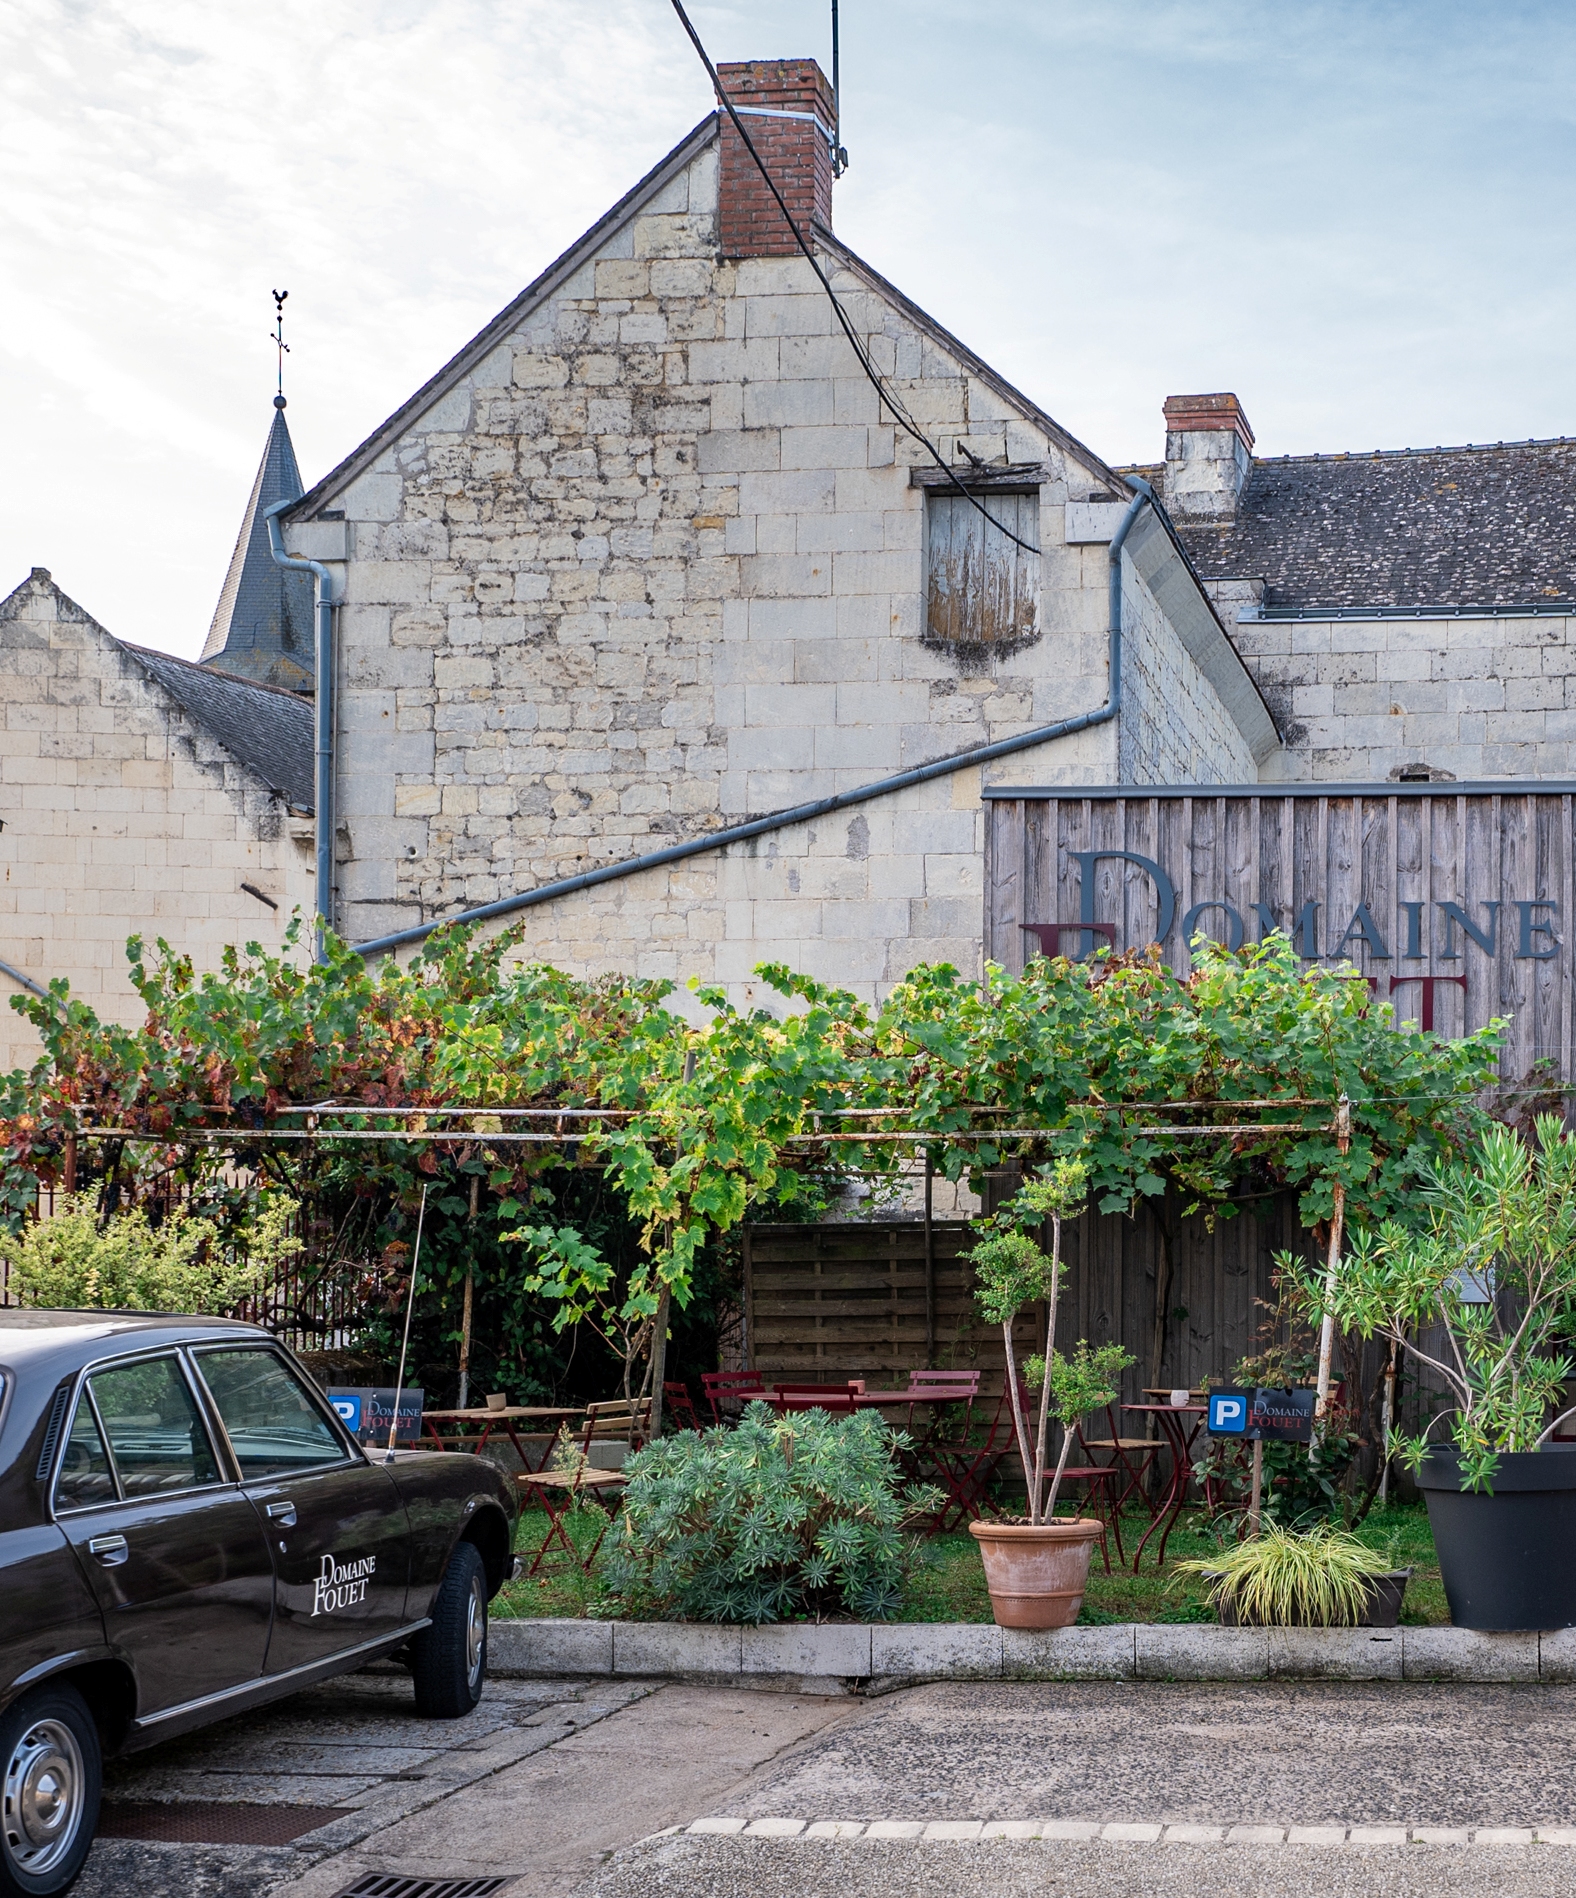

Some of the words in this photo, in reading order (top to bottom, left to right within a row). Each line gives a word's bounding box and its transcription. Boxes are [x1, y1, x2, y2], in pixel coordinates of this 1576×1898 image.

[1067, 850, 1564, 962] DOMAINE
[332, 1402, 355, 1420] P
[361, 1409, 414, 1428] FOUET
[367, 1400, 420, 1417] DOMAINE
[1216, 1400, 1240, 1425] P
[1253, 1400, 1310, 1418] DOMAINE
[1247, 1409, 1305, 1429] FOUET
[320, 1554, 376, 1589] DOMAINE
[311, 1576, 369, 1617] FOUET
